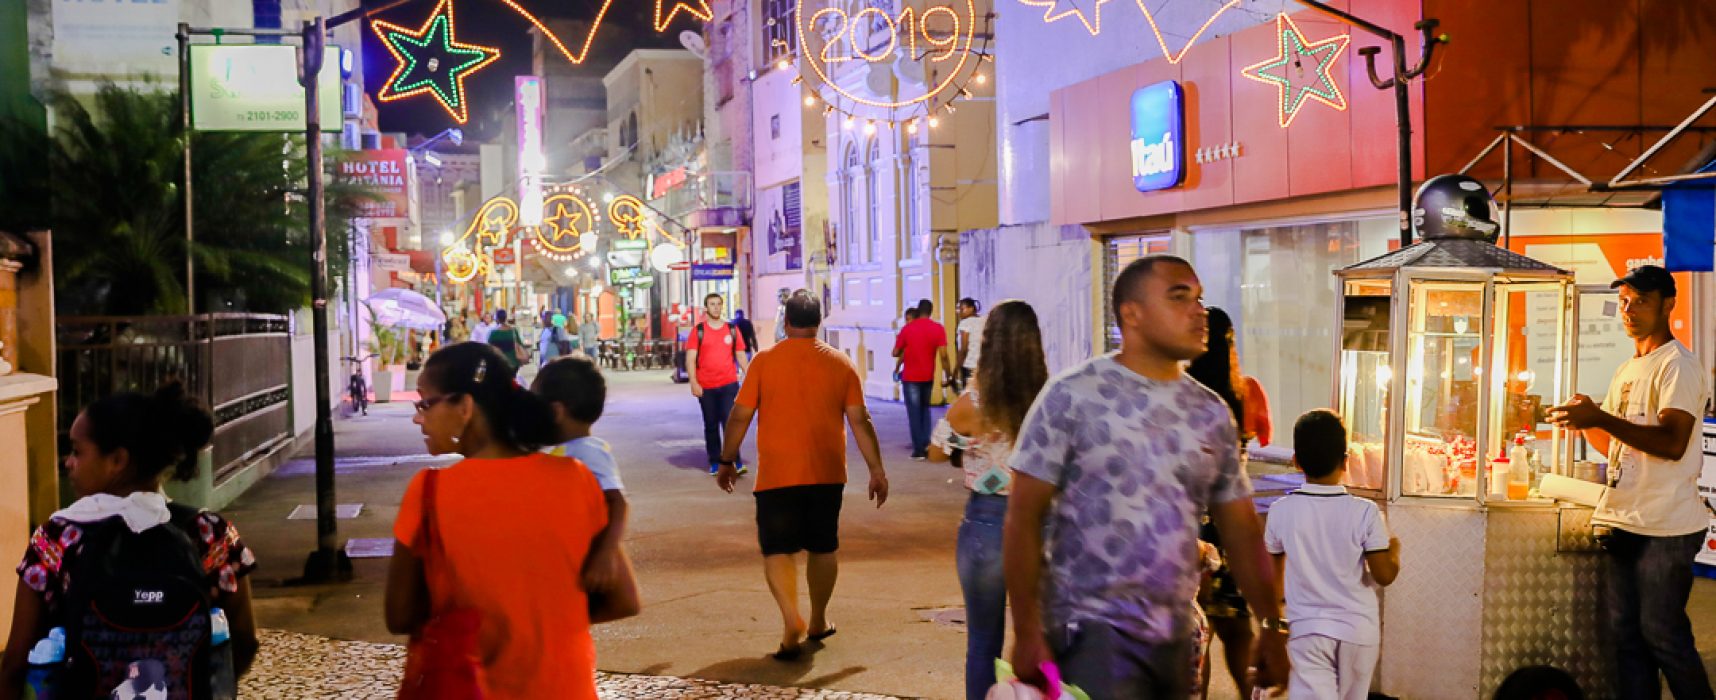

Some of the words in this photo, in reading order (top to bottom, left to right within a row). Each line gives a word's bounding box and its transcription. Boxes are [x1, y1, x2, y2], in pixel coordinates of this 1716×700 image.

[808, 6, 962, 62] 2019
[342, 160, 400, 174] HOTEL
[1131, 131, 1174, 176] Itaú
[134, 589, 164, 602] Yepp
